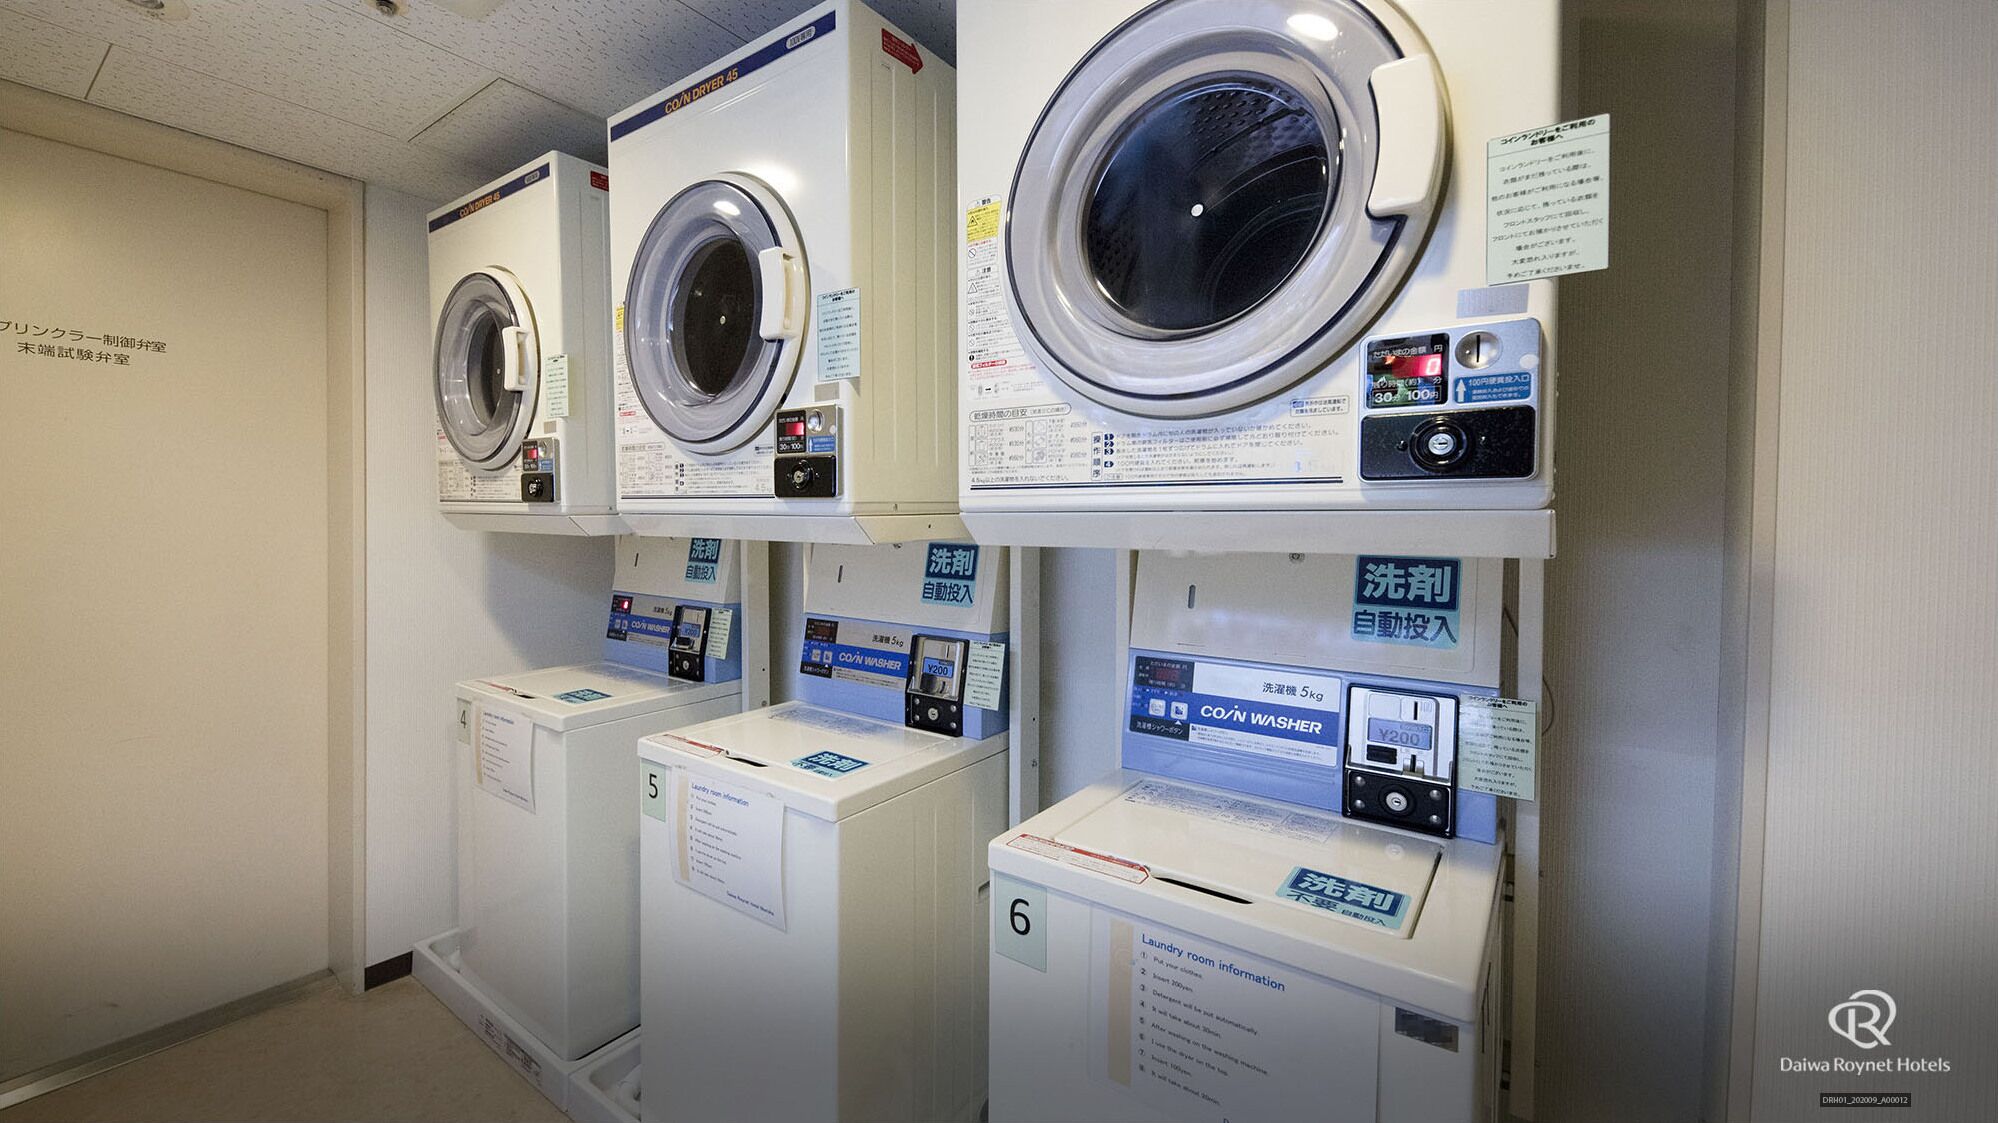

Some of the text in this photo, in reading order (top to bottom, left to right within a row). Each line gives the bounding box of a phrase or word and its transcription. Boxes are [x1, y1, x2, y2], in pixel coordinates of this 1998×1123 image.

[692, 75, 724, 99] DRYER
[726, 68, 738, 82] 45
[17, 341, 131, 366] 末端試験弁室
[1426, 357, 1441, 376] 0
[692, 538, 720, 560] 洗剤
[685, 564, 717, 581] 自動投入
[929, 547, 975, 576] 洗剤
[922, 581, 974, 604] 自動投入
[1362, 561, 1452, 604] 洗剤
[1353, 609, 1457, 643] 自動投入
[891, 635, 904, 648] 5kg
[865, 656, 902, 671] WASHER
[1262, 682, 1324, 702] 洗濯機 5kg
[460, 710, 467, 729] 4
[1250, 712, 1323, 735] WASHER
[648, 773, 659, 800] 5
[1298, 872, 1395, 911] 洗剤
[1009, 897, 1032, 936] 6
[1341, 909, 1387, 926] 自動投入
[1142, 934, 1286, 991] Laundry room information
[1153, 956, 1165, 966] Put
[1153, 989, 1181, 1005] Detergent
